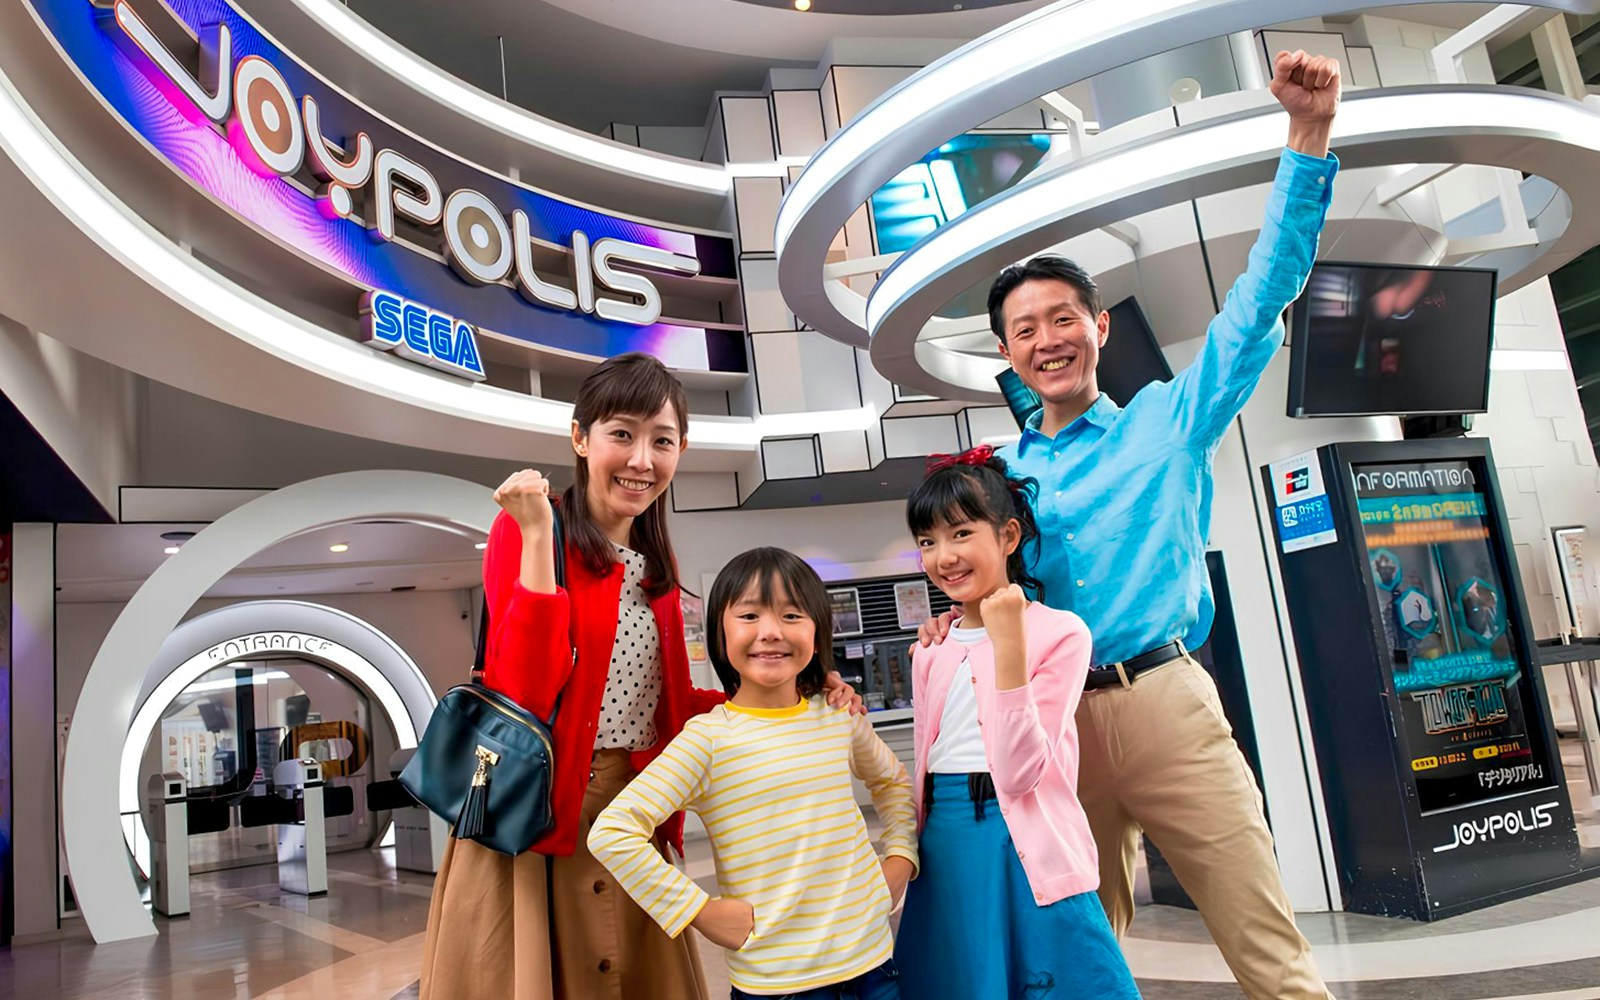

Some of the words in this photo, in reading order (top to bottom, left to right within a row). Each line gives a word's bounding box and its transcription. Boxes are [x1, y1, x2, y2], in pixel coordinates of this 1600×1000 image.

[114, 0, 701, 326] JOYPOLIS
[371, 290, 484, 374] SEGA
[208, 634, 333, 661] ENTRANCE
[1433, 801, 1560, 853] JOYPOLIS
